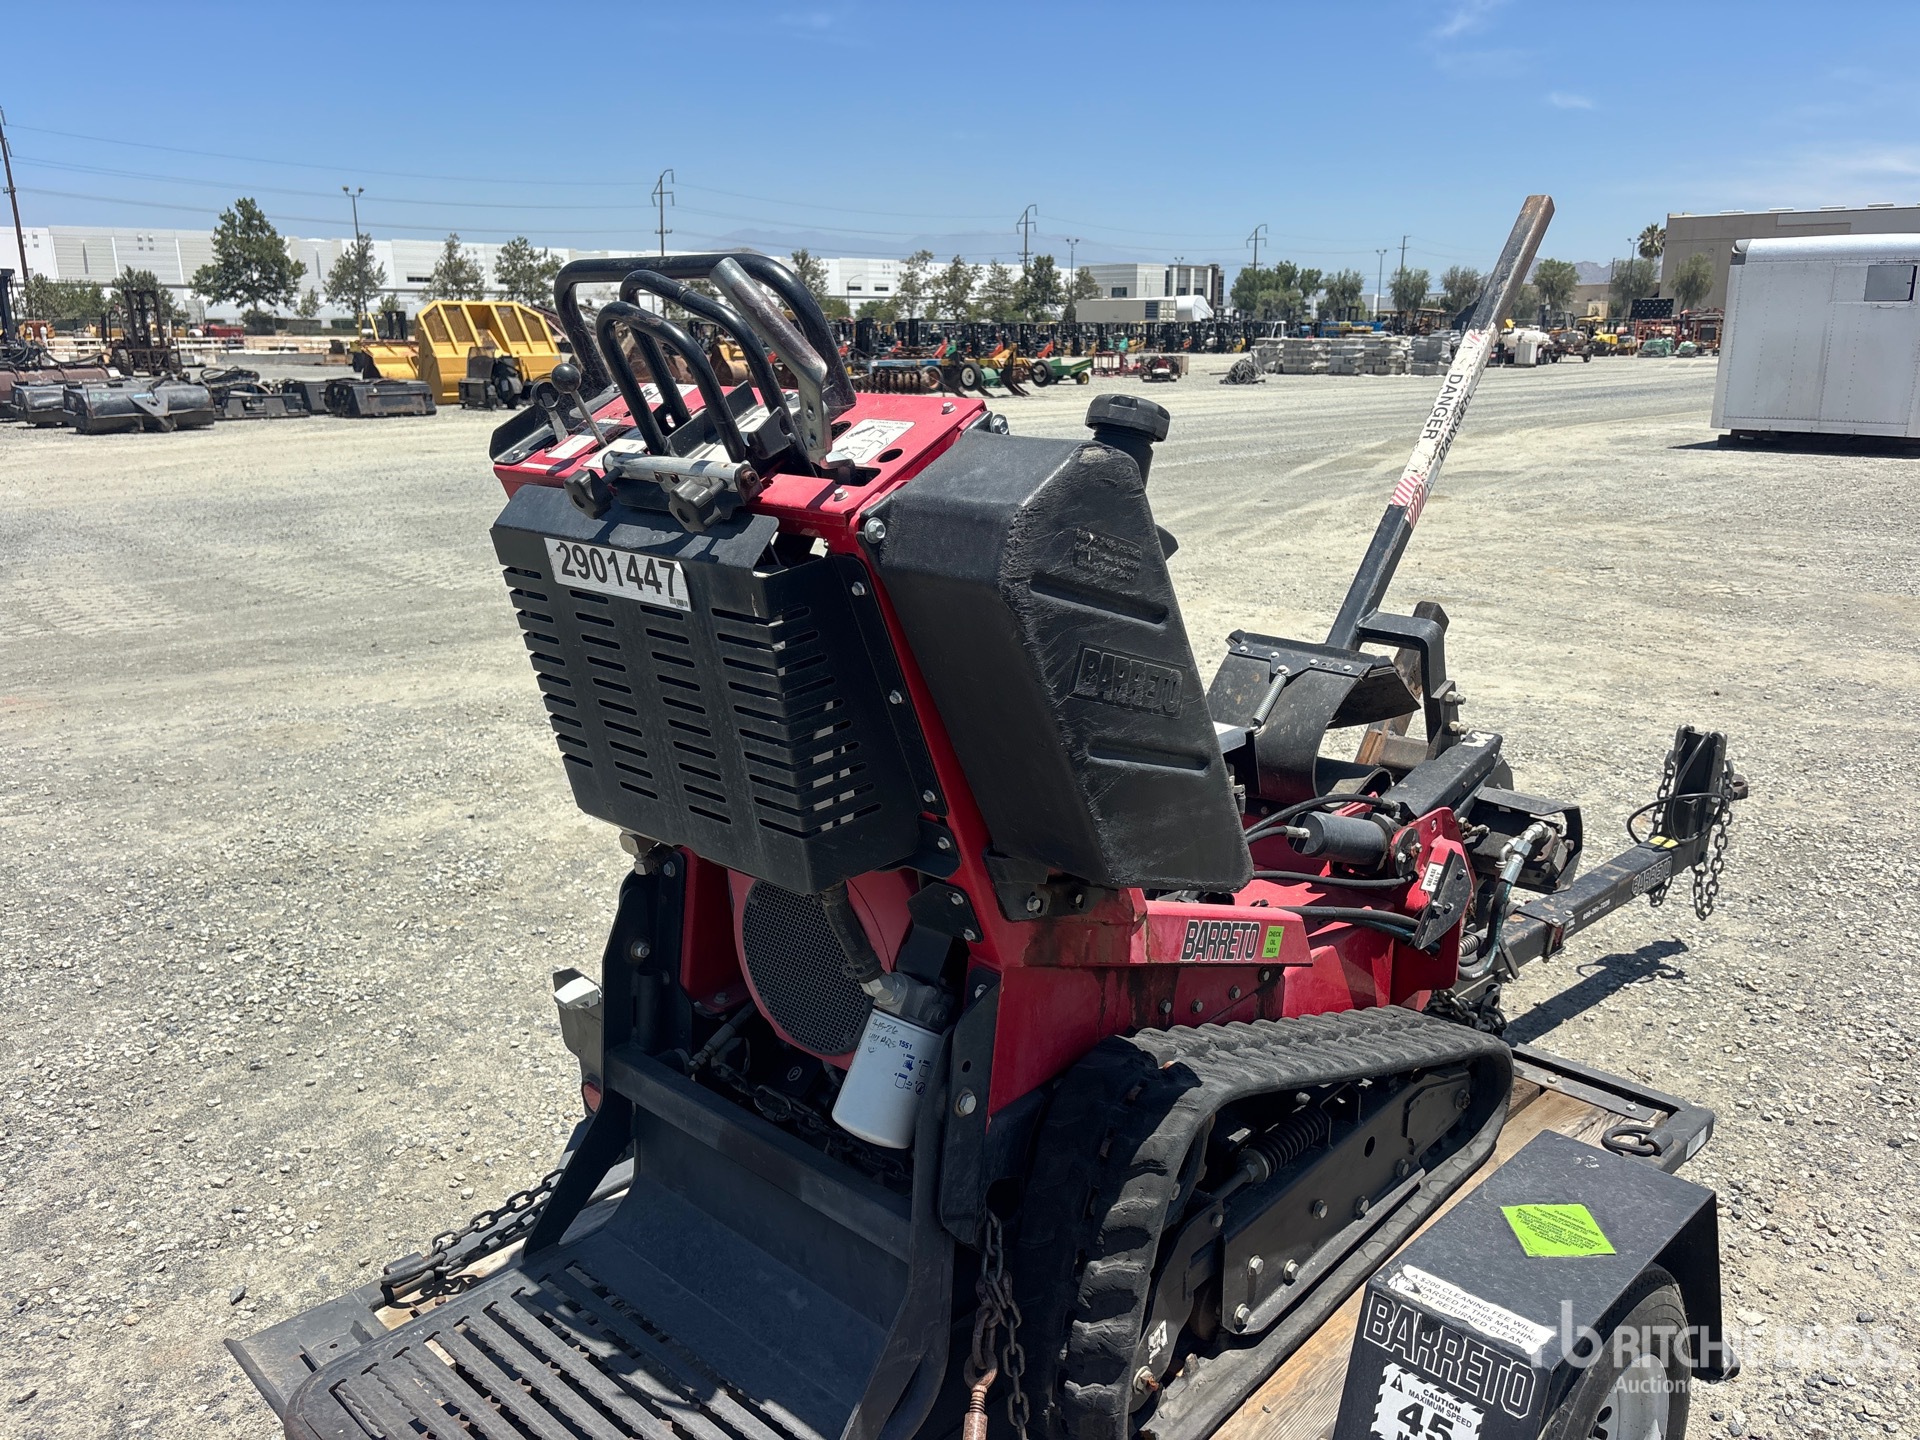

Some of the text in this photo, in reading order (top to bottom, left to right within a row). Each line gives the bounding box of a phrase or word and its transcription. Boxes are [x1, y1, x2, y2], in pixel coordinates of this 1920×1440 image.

[1422, 373, 1464, 440] DANGER
[556, 541, 676, 597] 2901447
[1074, 646, 1183, 716] BARRETO
[1632, 856, 1673, 896] BARRETO
[1180, 919, 1261, 962] BARRETO
[898, 1039, 913, 1050] 1551
[1419, 1276, 1441, 1290] $200
[1442, 1287, 1491, 1313] CLEANING
[1491, 1309, 1514, 1323] FEE
[1513, 1319, 1536, 1335] WILL
[1435, 1300, 1488, 1328] RETURNED
[1489, 1325, 1524, 1345] CLEAN
[1460, 1303, 1470, 1311] IF
[1471, 1308, 1493, 1323] THIS
[1494, 1318, 1542, 1344] MACHINE
[1362, 1292, 1536, 1419] BARRETO
[1397, 1402, 1454, 1440] 45
[1408, 1389, 1472, 1428] MAXIMUM SPEED
[1423, 1388, 1461, 1413] CAUTION
